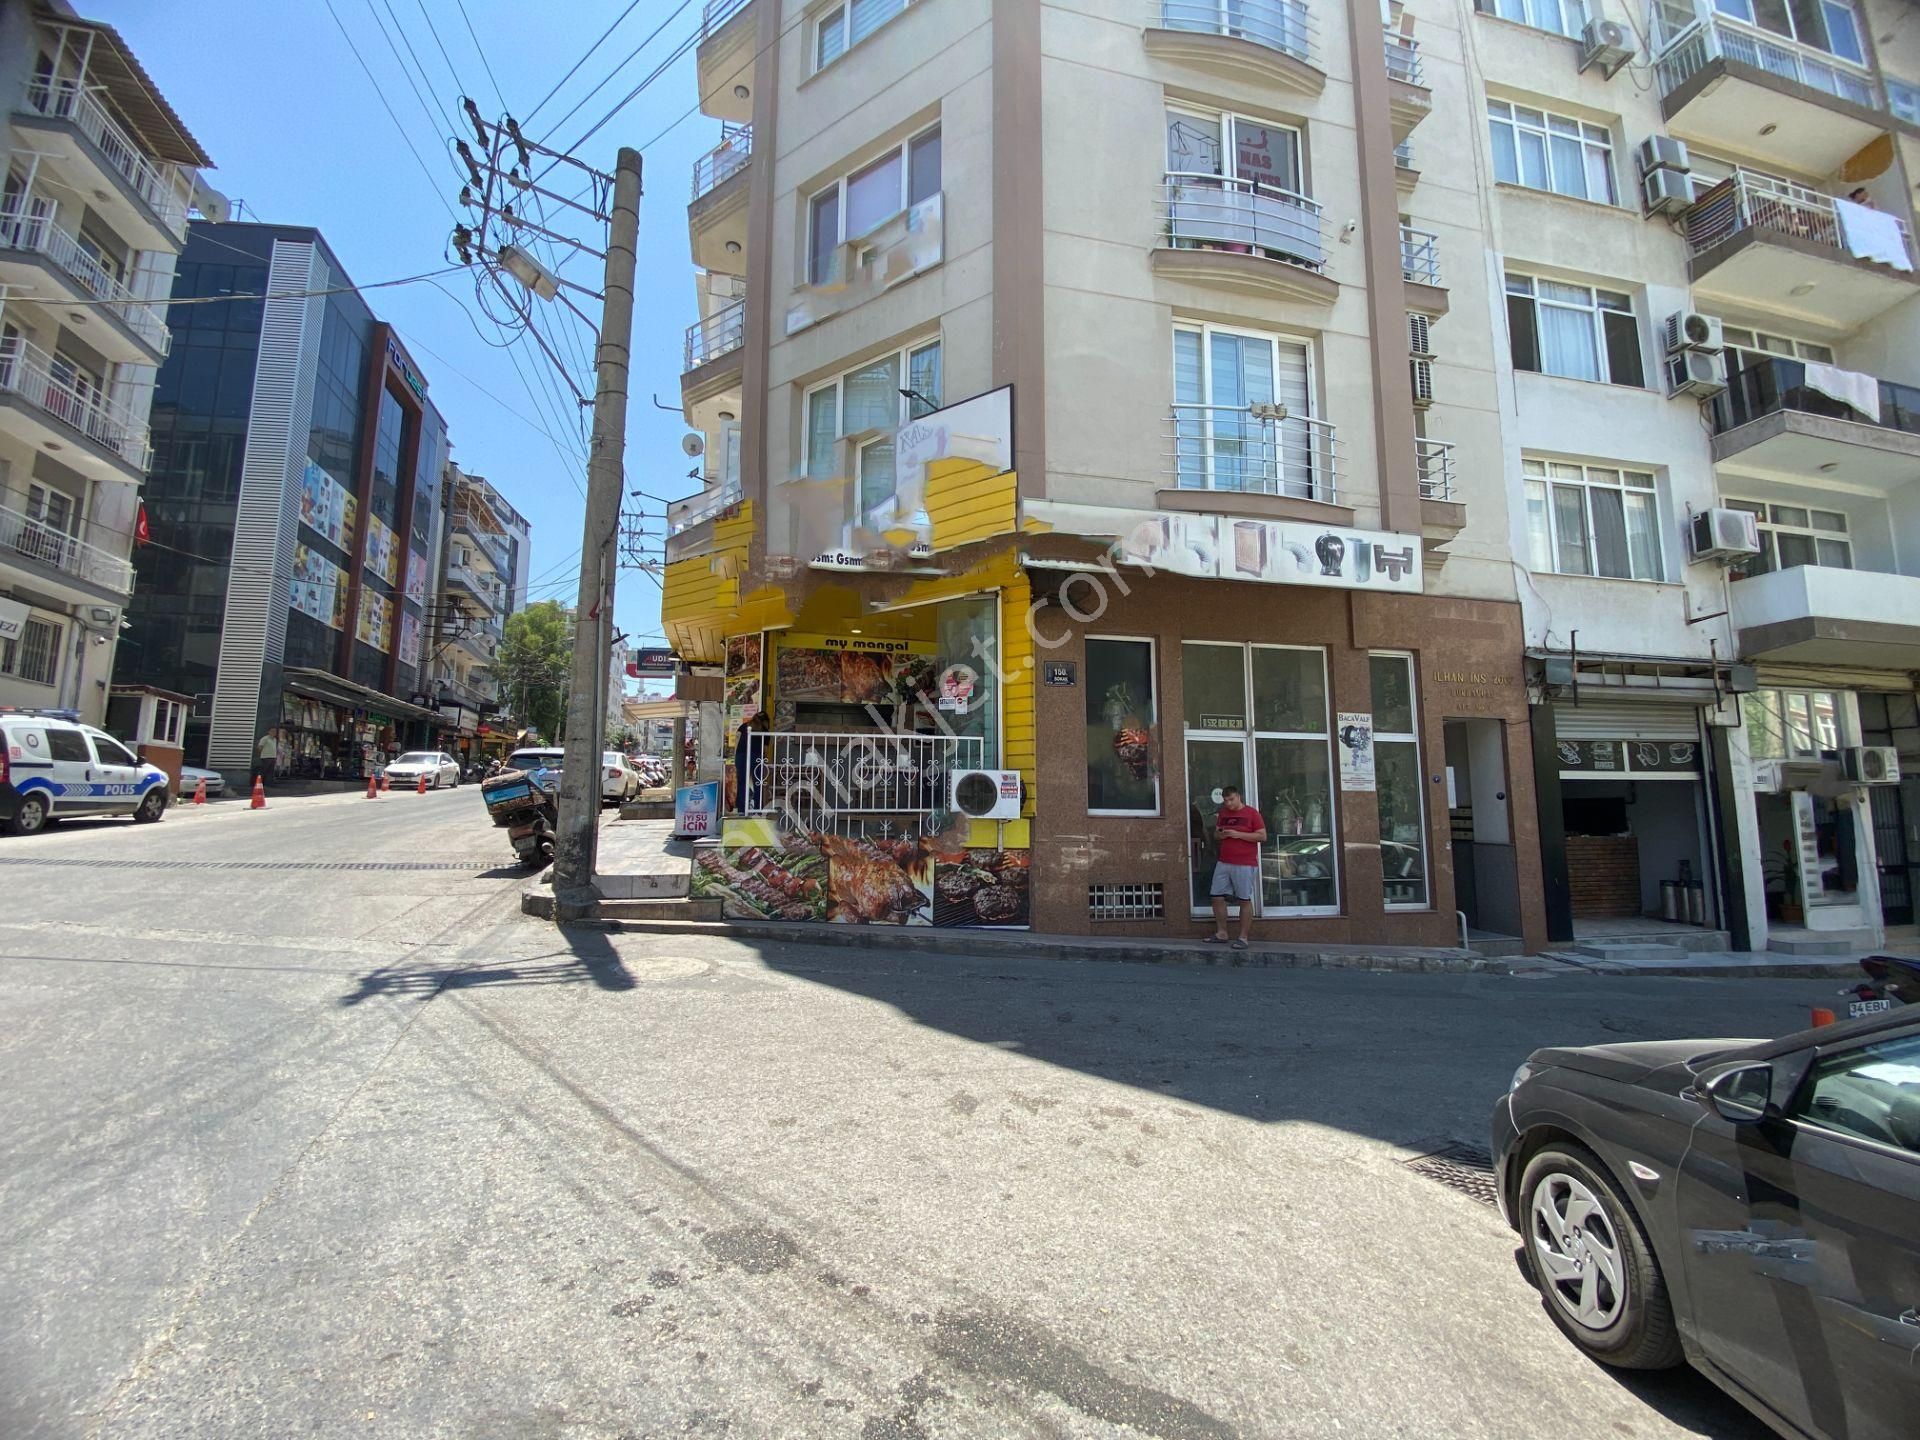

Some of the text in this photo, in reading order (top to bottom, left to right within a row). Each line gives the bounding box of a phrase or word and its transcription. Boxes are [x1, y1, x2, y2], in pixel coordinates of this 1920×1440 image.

[1240, 150, 1272, 169] NAS
[825, 639, 909, 652] my mangal
